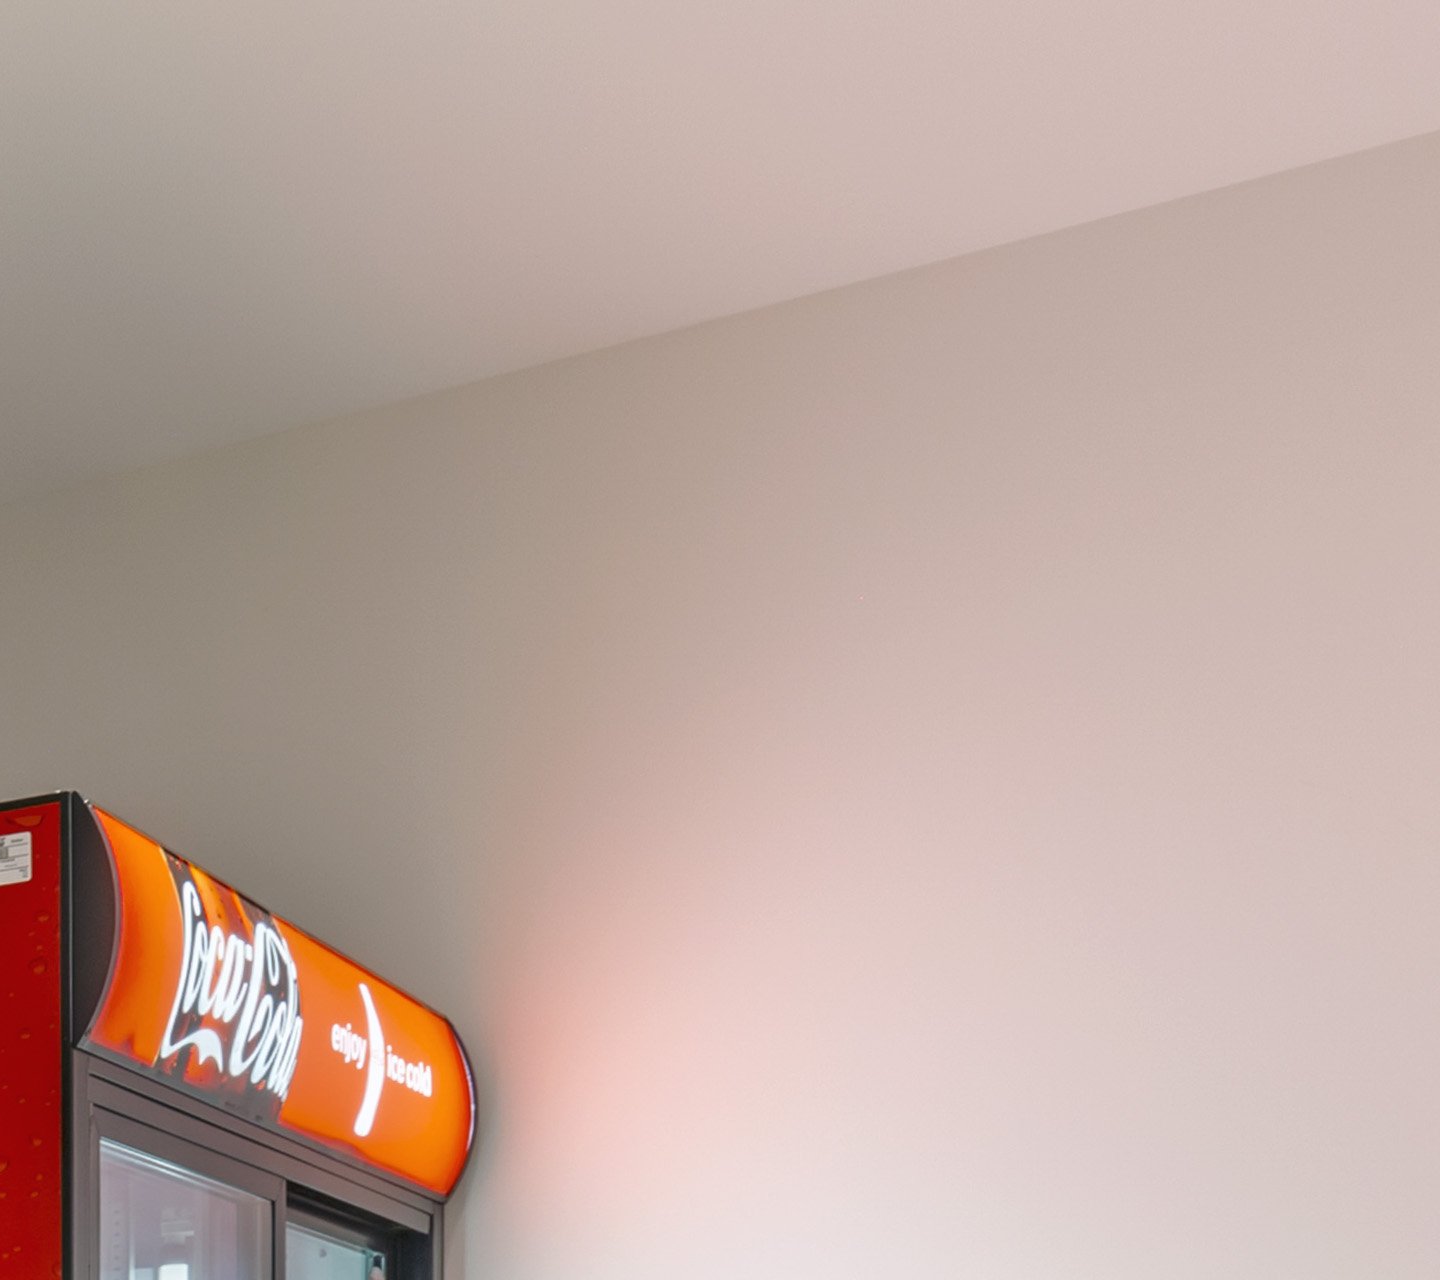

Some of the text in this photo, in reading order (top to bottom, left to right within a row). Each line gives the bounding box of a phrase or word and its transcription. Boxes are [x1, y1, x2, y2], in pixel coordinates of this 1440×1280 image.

[331, 1023, 367, 1069] enjoy
[387, 1046, 432, 1096] ice cold
